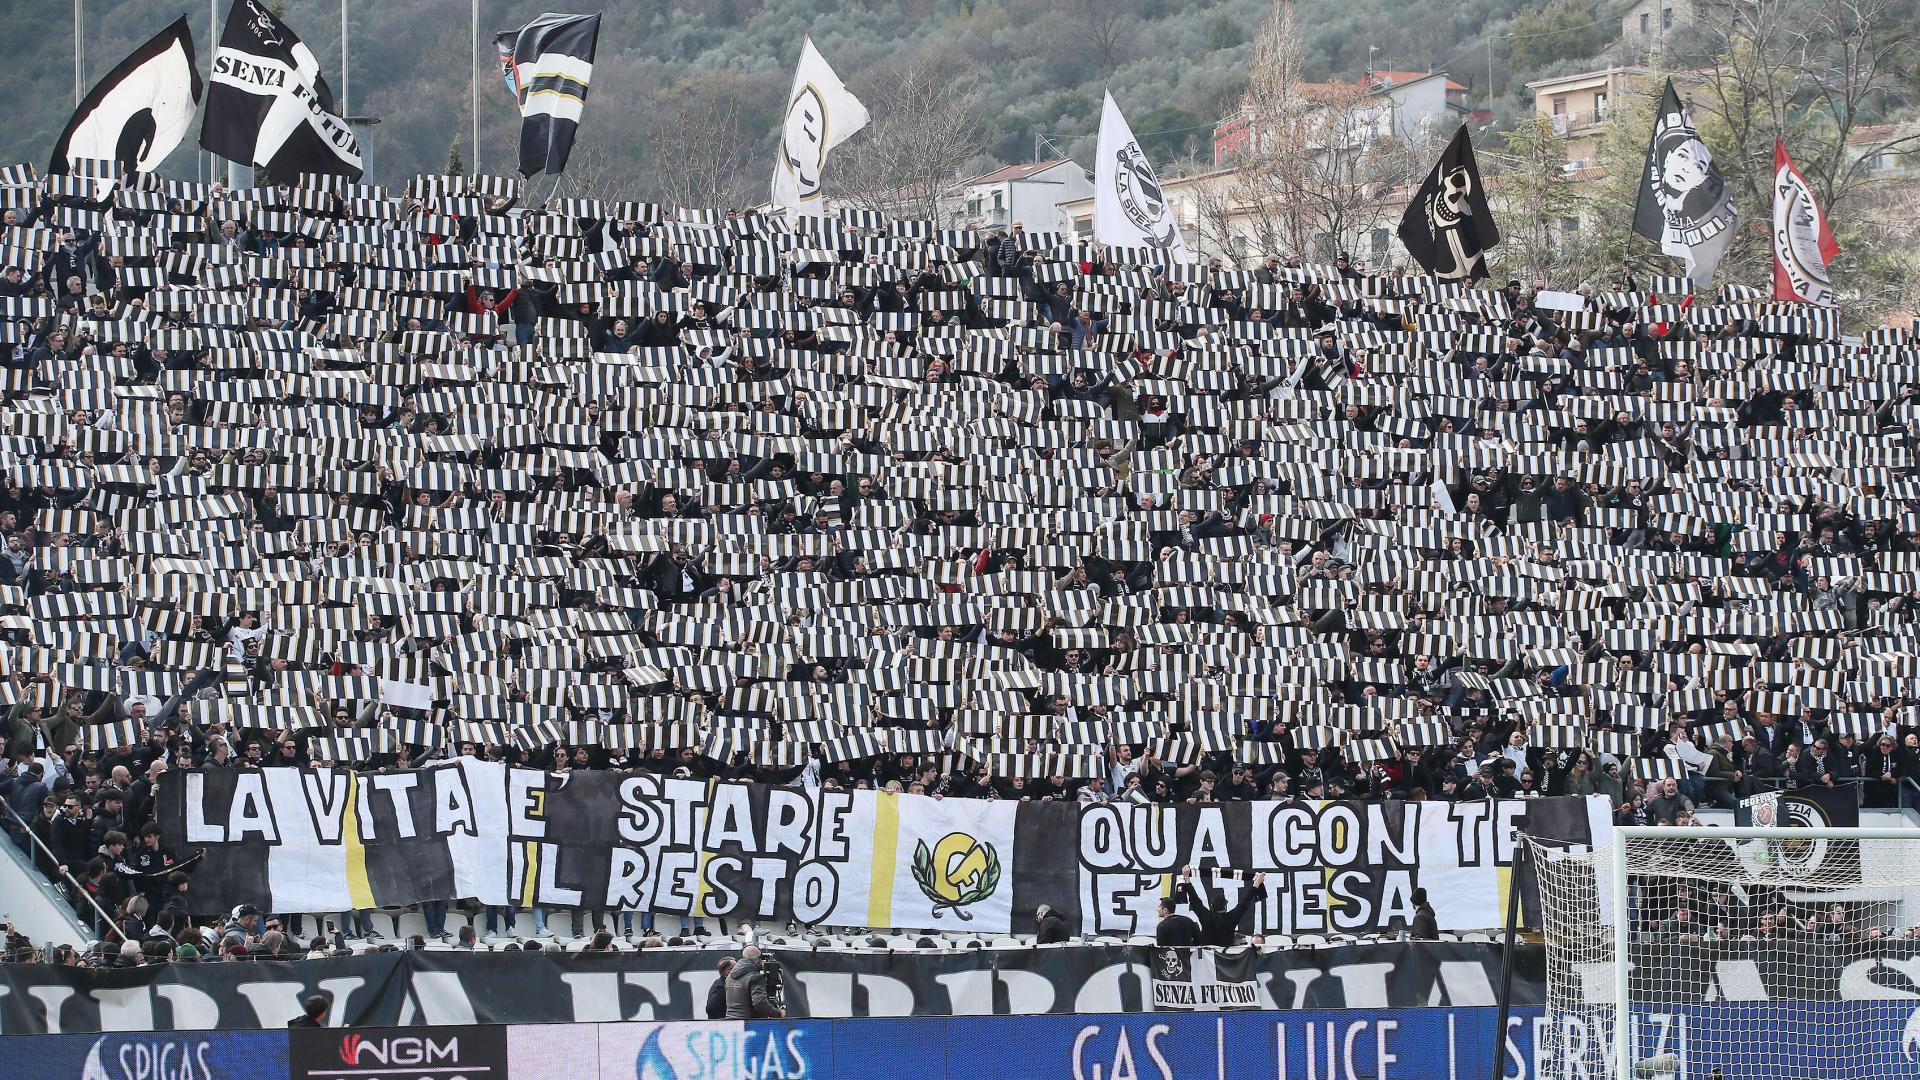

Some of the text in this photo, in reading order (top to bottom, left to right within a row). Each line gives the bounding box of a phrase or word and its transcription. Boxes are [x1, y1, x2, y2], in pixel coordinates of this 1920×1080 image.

[247, 19, 262, 38] 1906
[213, 55, 286, 88] SENZA
[1119, 171, 1128, 195] LA
[184, 770, 280, 845] LA
[302, 765, 478, 845] VITA
[507, 765, 572, 840] E'
[615, 773, 852, 862] STARE
[1079, 800, 1233, 871] QUA
[1268, 799, 1420, 871] CON
[507, 838, 584, 908] IL
[603, 844, 843, 928] RESTO
[1155, 983, 1257, 1005] SENZA FUTURO
[119, 1041, 212, 1080] SPIGAS
[354, 1036, 459, 1065] NGM
[685, 1029, 808, 1080] SPIGAS
[1072, 1024, 1174, 1080] GAS
[1277, 1020, 1398, 1080] LUCE
